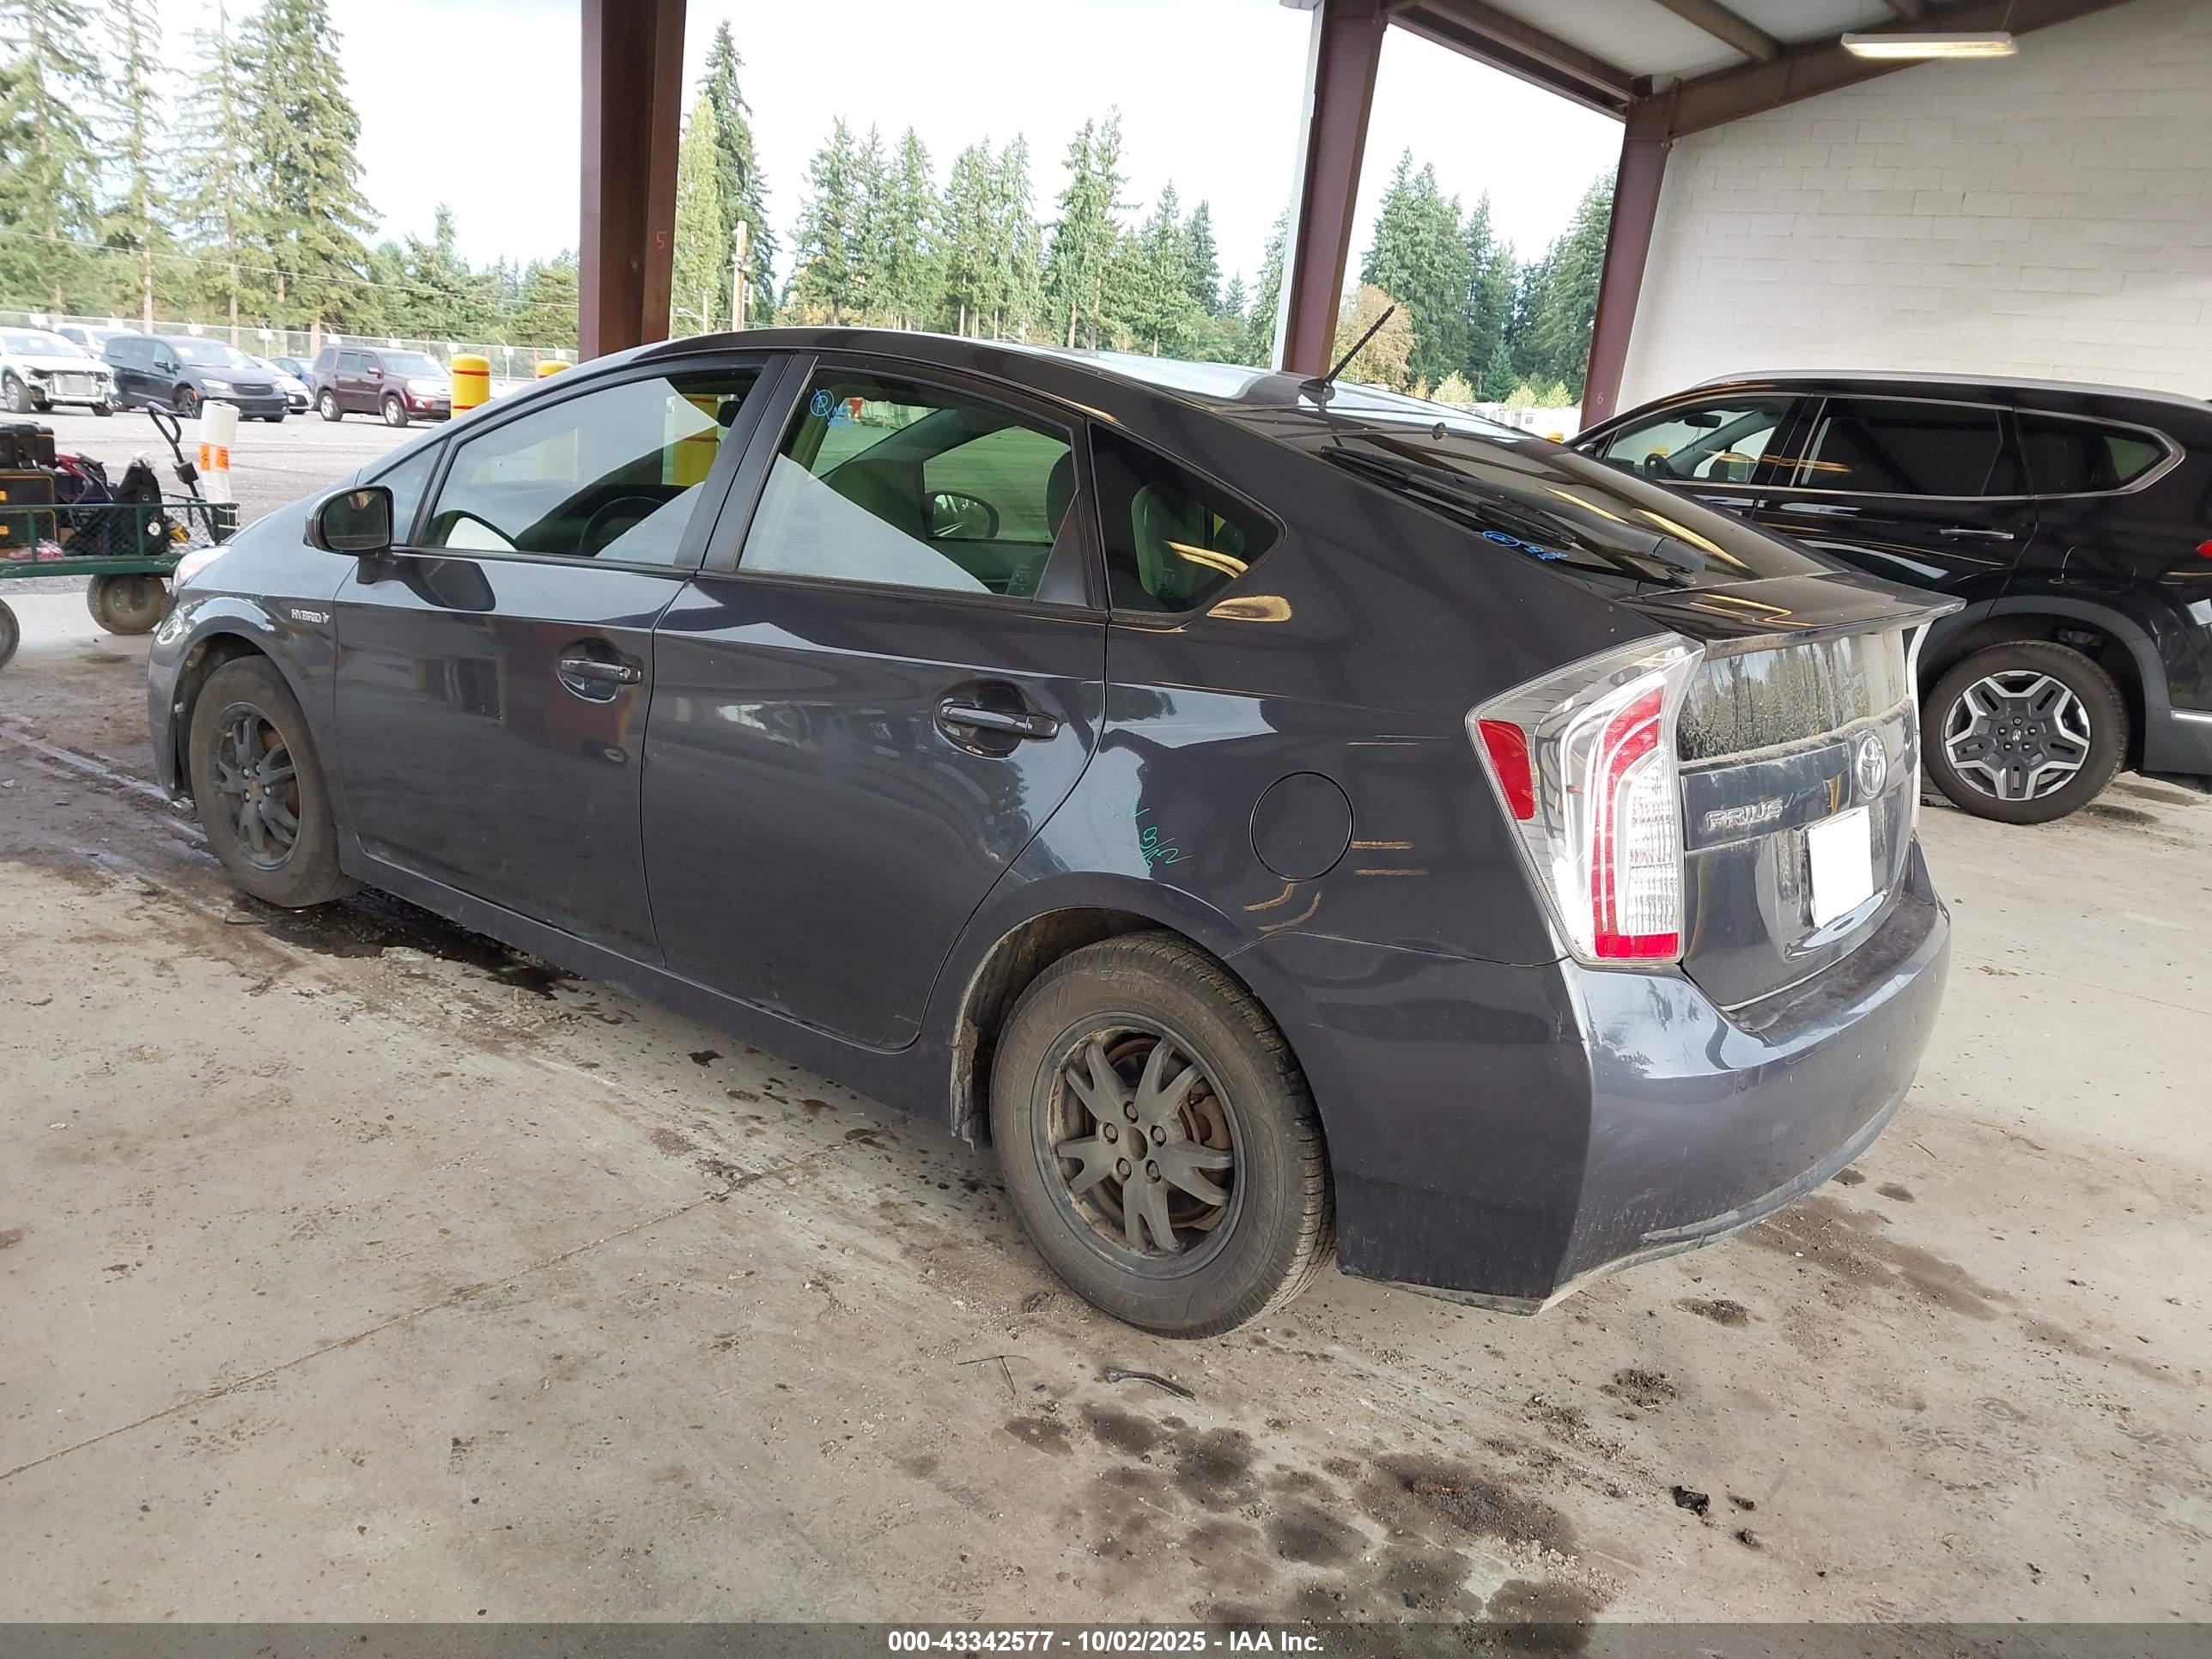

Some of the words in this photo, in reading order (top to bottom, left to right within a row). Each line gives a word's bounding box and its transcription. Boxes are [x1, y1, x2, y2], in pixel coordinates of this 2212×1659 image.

[656, 230, 667, 249] 5
[291, 608, 322, 623] HYBRID
[1706, 799, 1783, 831] PRIUS
